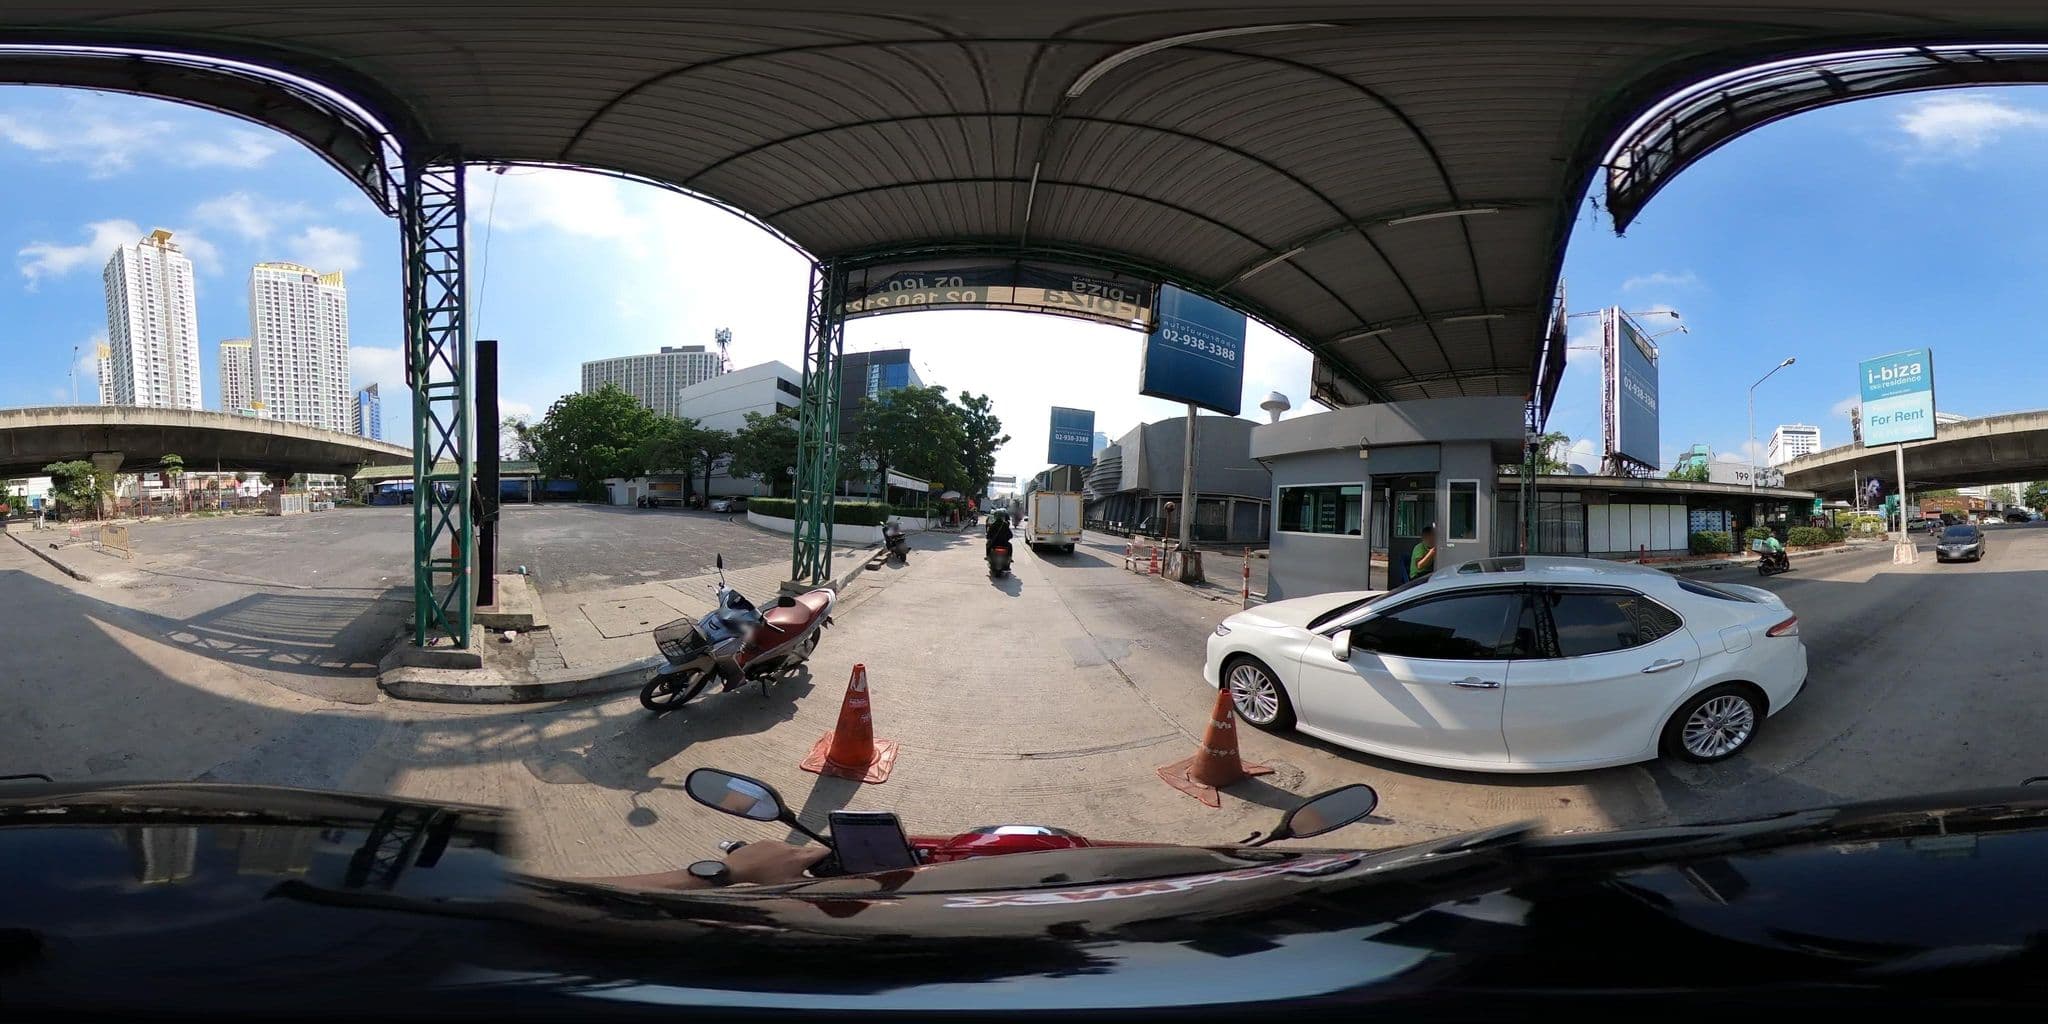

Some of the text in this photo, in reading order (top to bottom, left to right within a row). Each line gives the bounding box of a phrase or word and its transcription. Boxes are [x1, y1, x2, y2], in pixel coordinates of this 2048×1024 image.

[1163, 328, 1235, 361] 02-938-3388
[1868, 362, 1921, 384] i-biza
[1871, 409, 1924, 426] For Rent
[1735, 471, 1749, 480] 199
